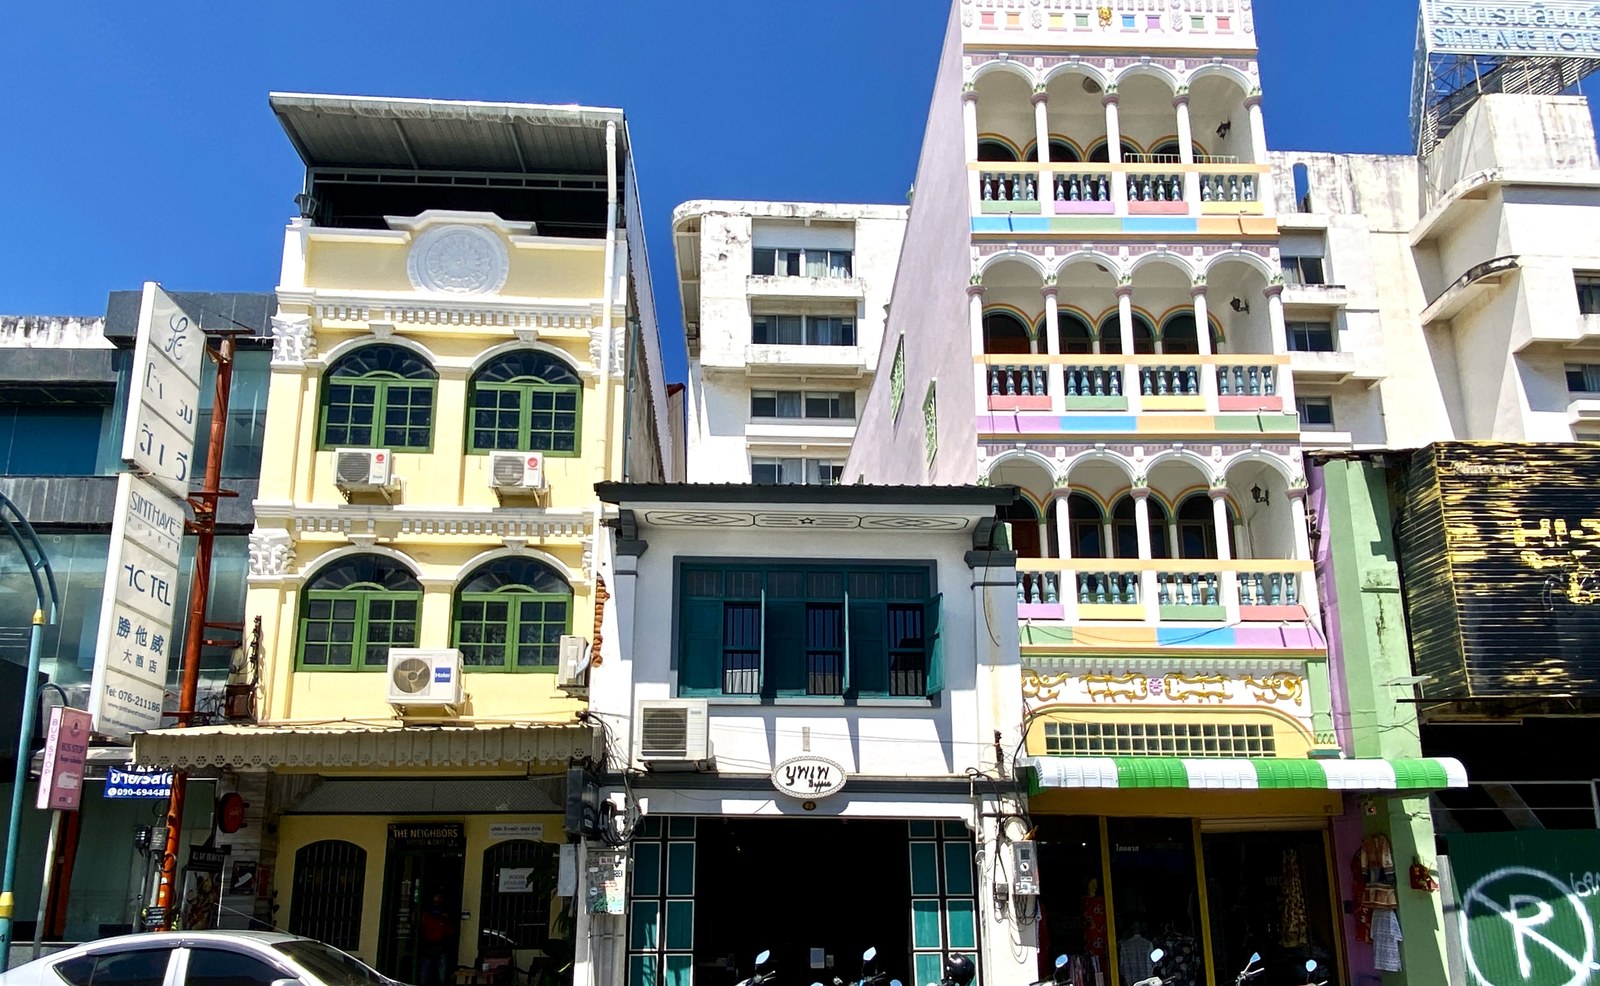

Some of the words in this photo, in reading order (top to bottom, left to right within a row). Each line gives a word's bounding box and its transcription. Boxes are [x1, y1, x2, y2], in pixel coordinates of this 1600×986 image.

[50, 719, 59, 741] BUS
[45, 746, 55, 775] STOP
[393, 828, 409, 838] THE
[410, 828, 458, 838] NEIGHBORS
